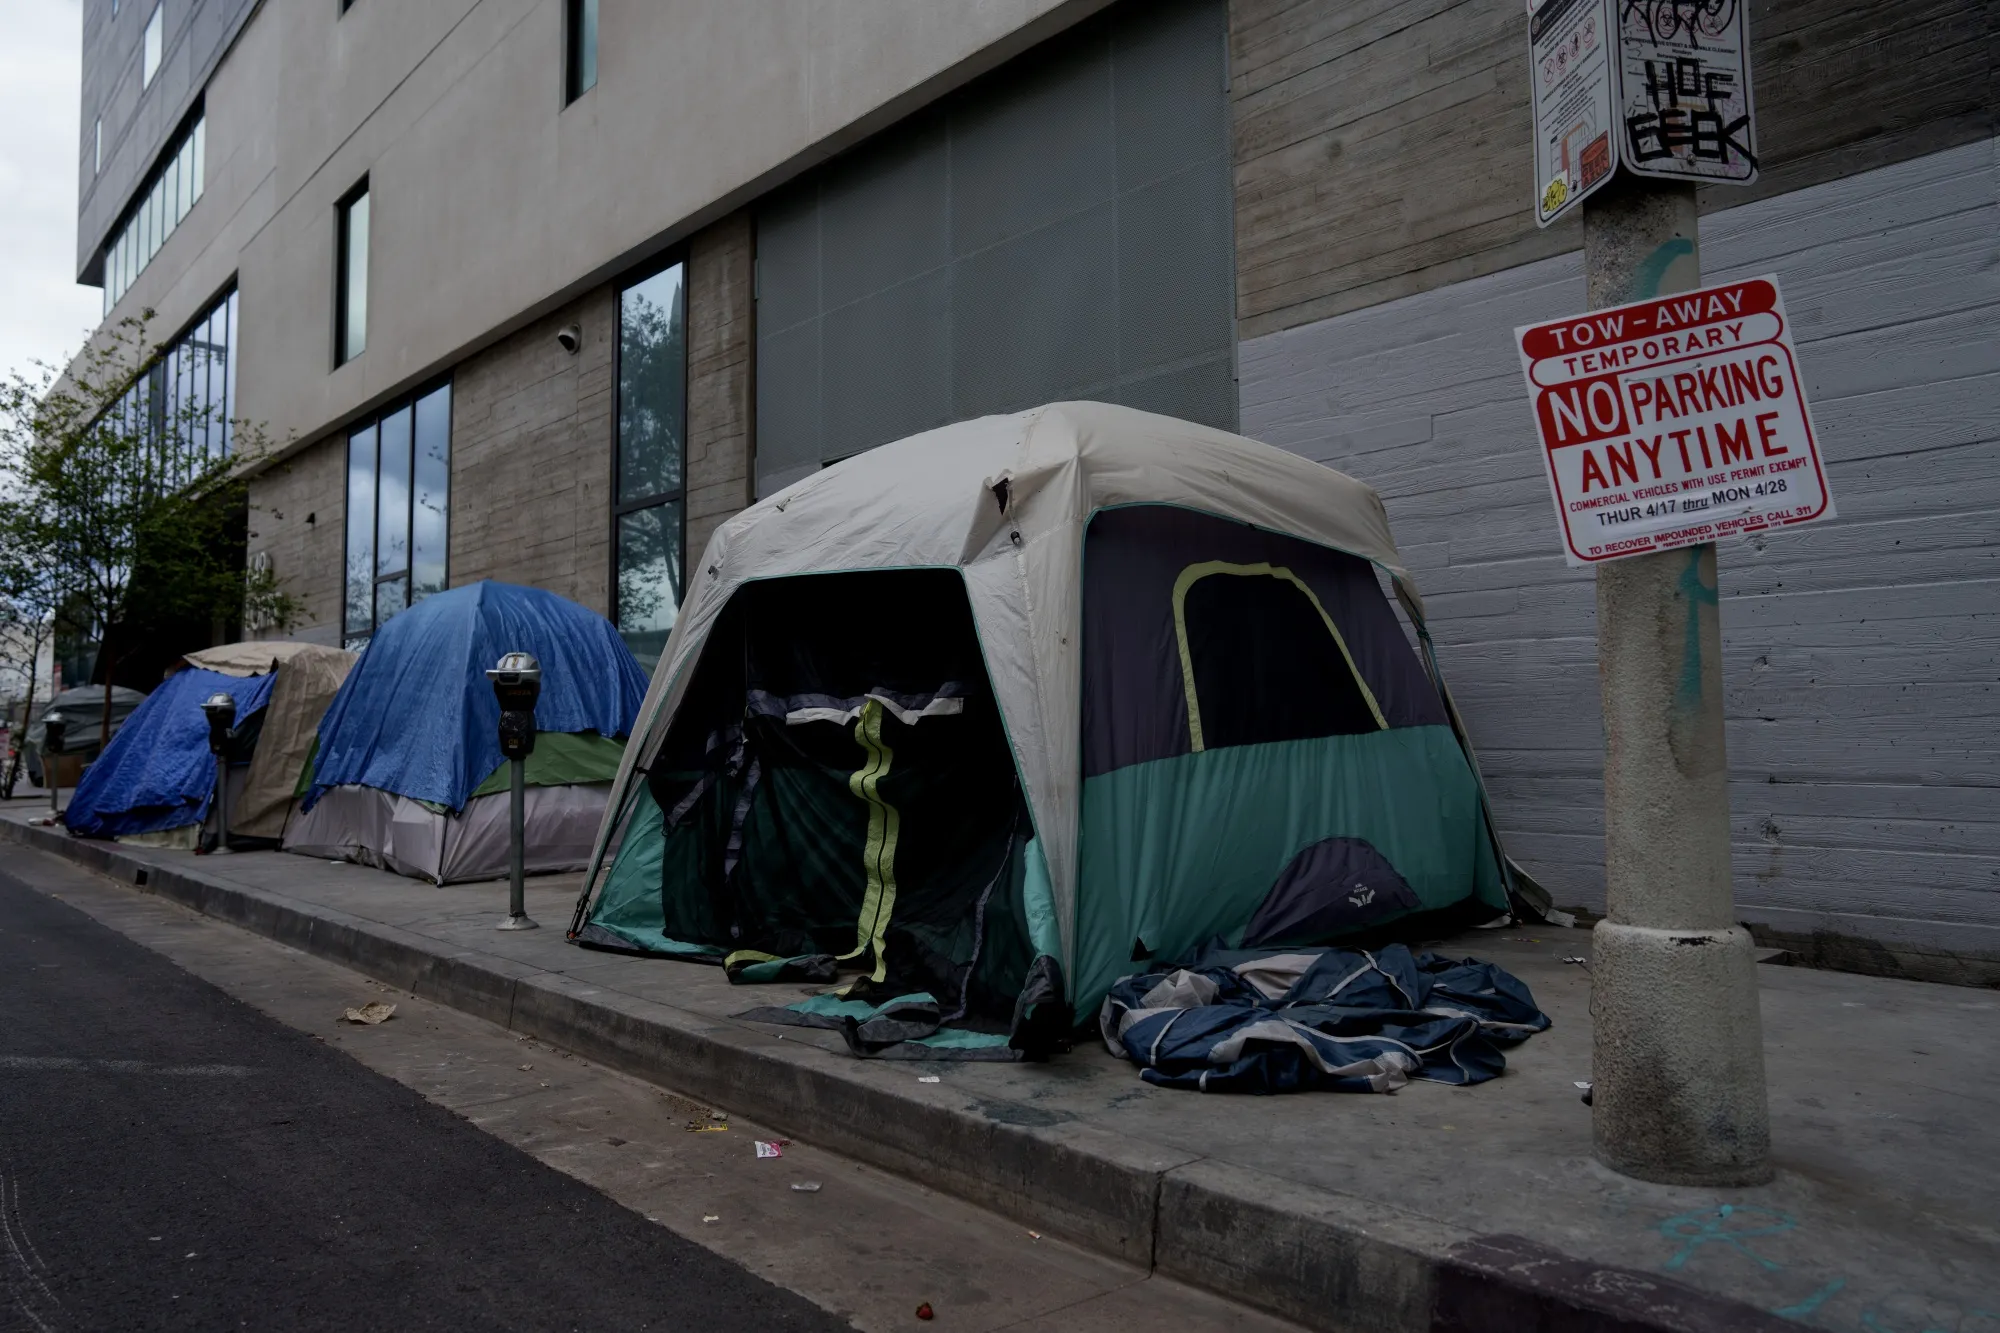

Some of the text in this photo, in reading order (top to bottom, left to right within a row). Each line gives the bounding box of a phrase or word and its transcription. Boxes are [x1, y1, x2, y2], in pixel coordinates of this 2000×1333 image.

[1563, 321, 1744, 377] TEMPORARY
[1548, 355, 1784, 442] NO PARKING
[1582, 411, 1789, 493] ANYTIME
[1570, 456, 1807, 512] COMMERCIAL VEHICLES WITH USE PERMIT EXEMPT
[1596, 478, 1787, 526] THUR 4/17 thru MON 4/28
[1588, 545, 1602, 555] TO
[1605, 536, 1651, 552] RECOVER
[1654, 524, 1712, 543] IMPOUNDED
[1715, 514, 1764, 531] VEHICLES
[1767, 509, 1793, 521] CALL
[1796, 505, 1811, 516] 311
